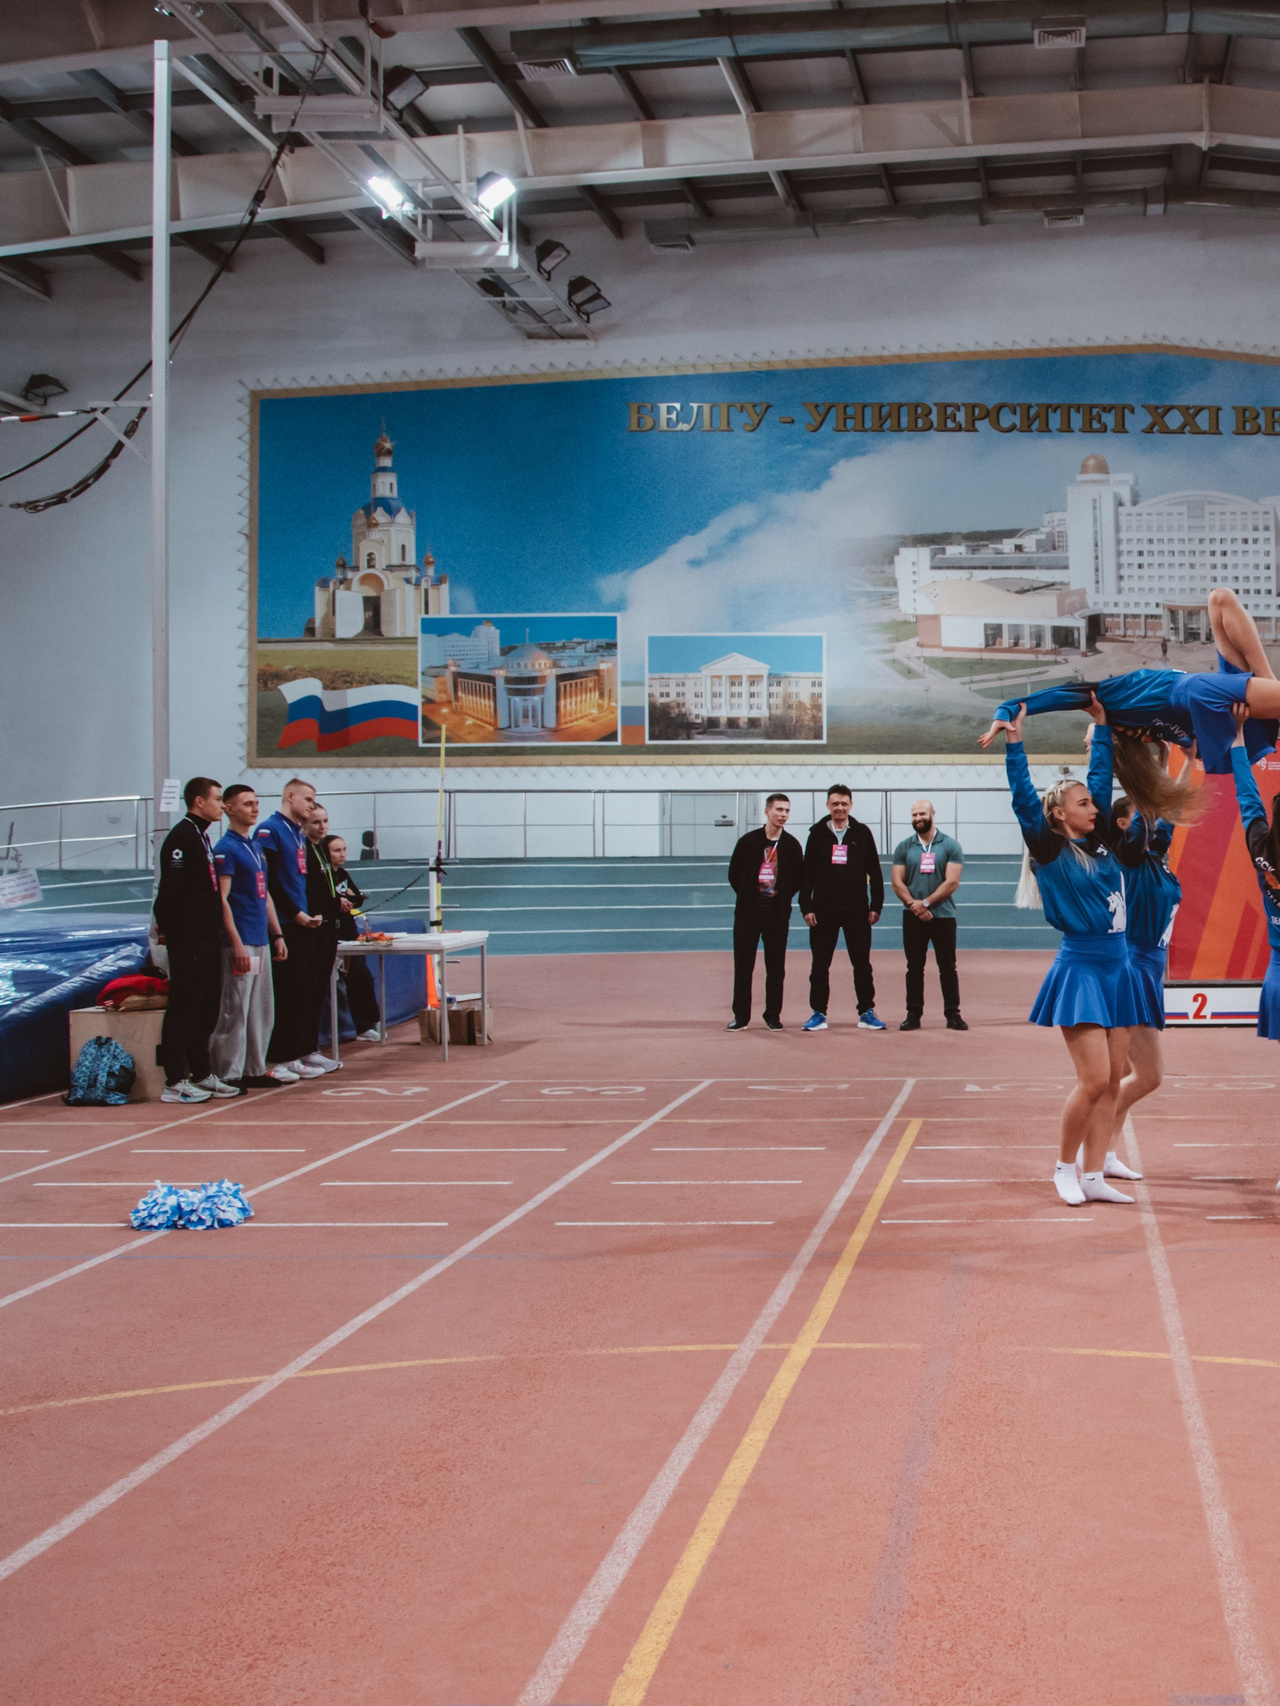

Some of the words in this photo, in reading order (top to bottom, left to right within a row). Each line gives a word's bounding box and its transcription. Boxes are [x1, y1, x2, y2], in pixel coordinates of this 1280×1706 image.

[626, 402, 774, 432] БЕЛГУ
[804, 402, 1135, 434] УНИВЕРСИТЕТ
[1141, 404, 1224, 436] XXI
[1192, 993, 1208, 1020] 2
